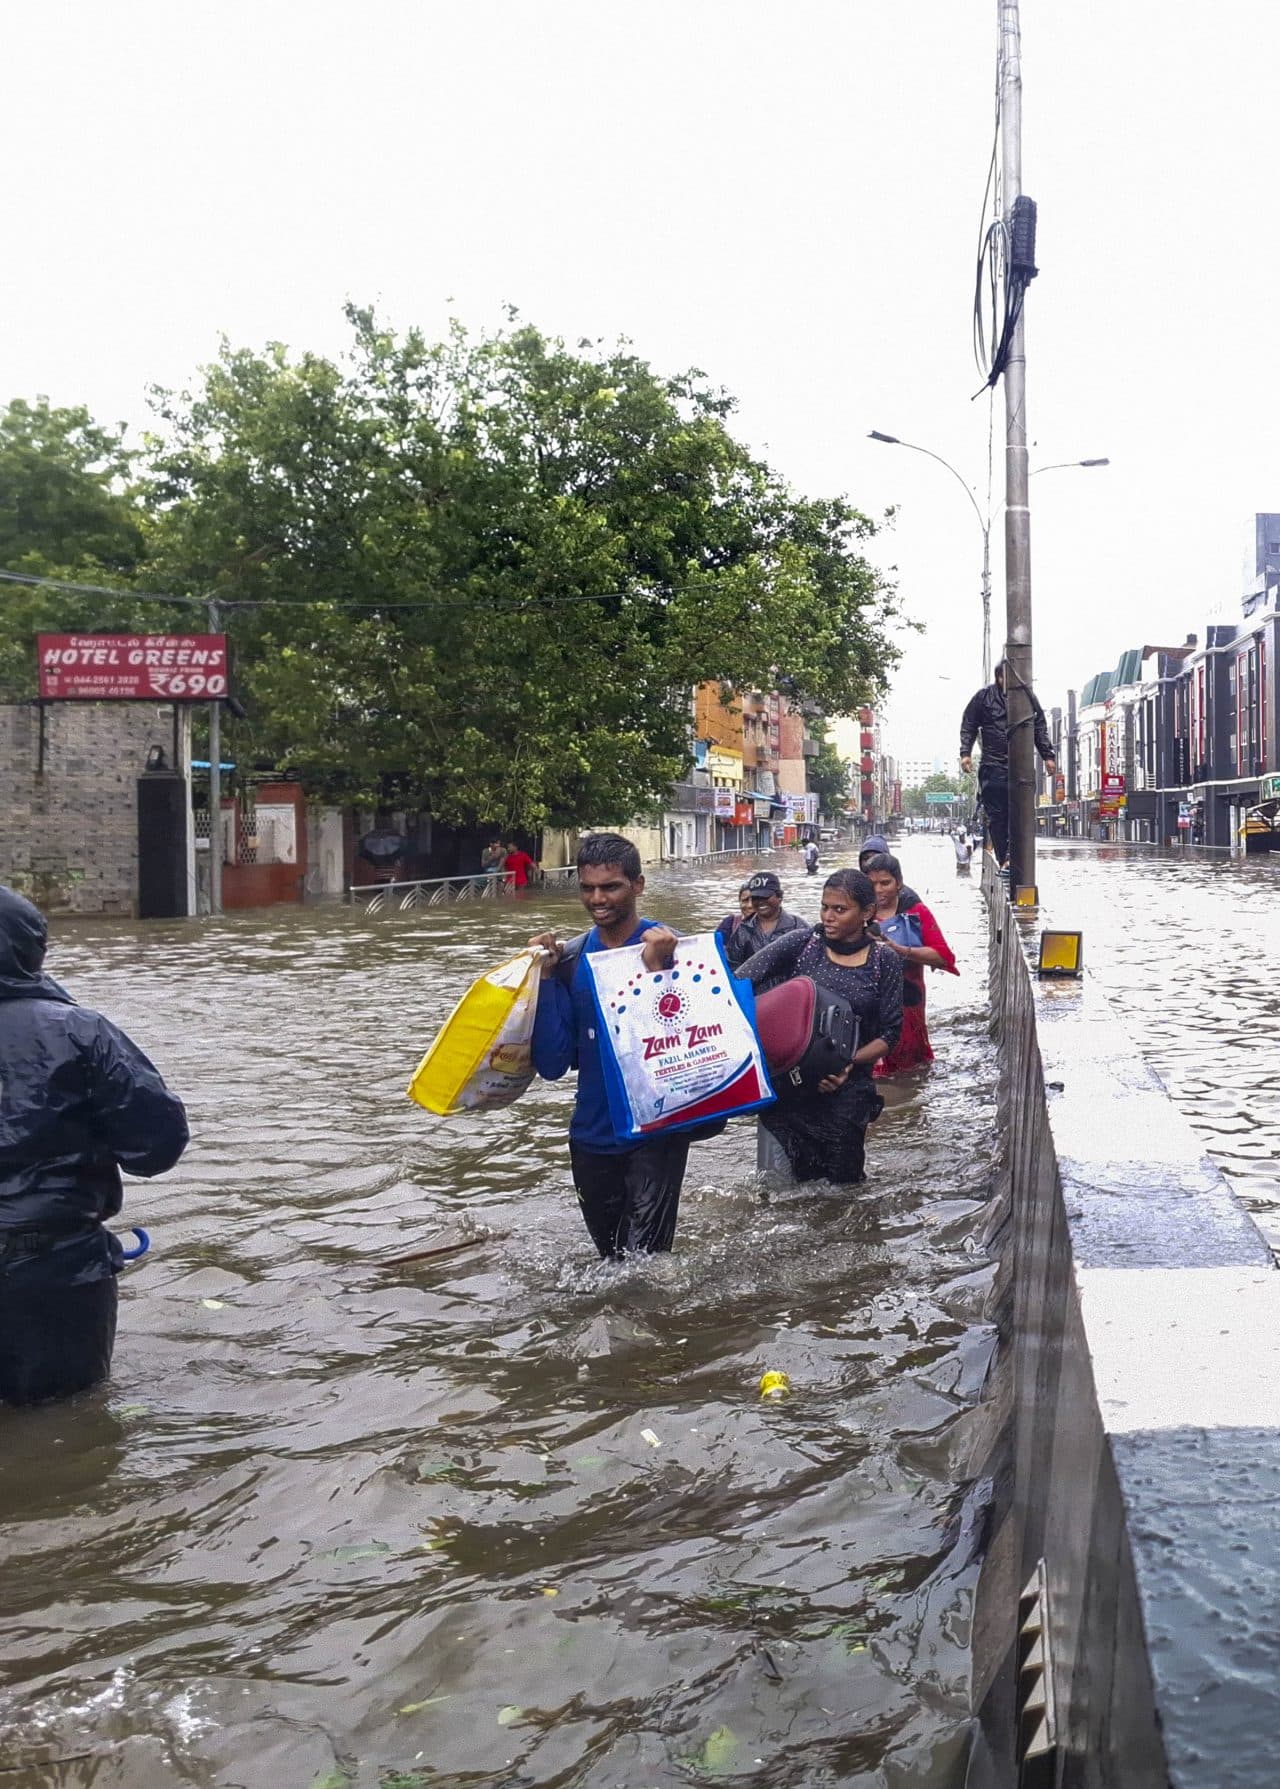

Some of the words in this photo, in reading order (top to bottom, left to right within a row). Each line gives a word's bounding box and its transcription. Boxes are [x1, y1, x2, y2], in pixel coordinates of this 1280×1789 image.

[44, 649, 120, 664] HOTEL
[128, 650, 223, 665] GREENS
[642, 1034, 681, 1060] Zam
[685, 1024, 723, 1049] Zam
[654, 1063, 686, 1077] TEXTILES
[693, 1051, 728, 1065] GARMENTS
[658, 1055, 682, 1067] FAZIL
[684, 1045, 717, 1059] AHAMED
